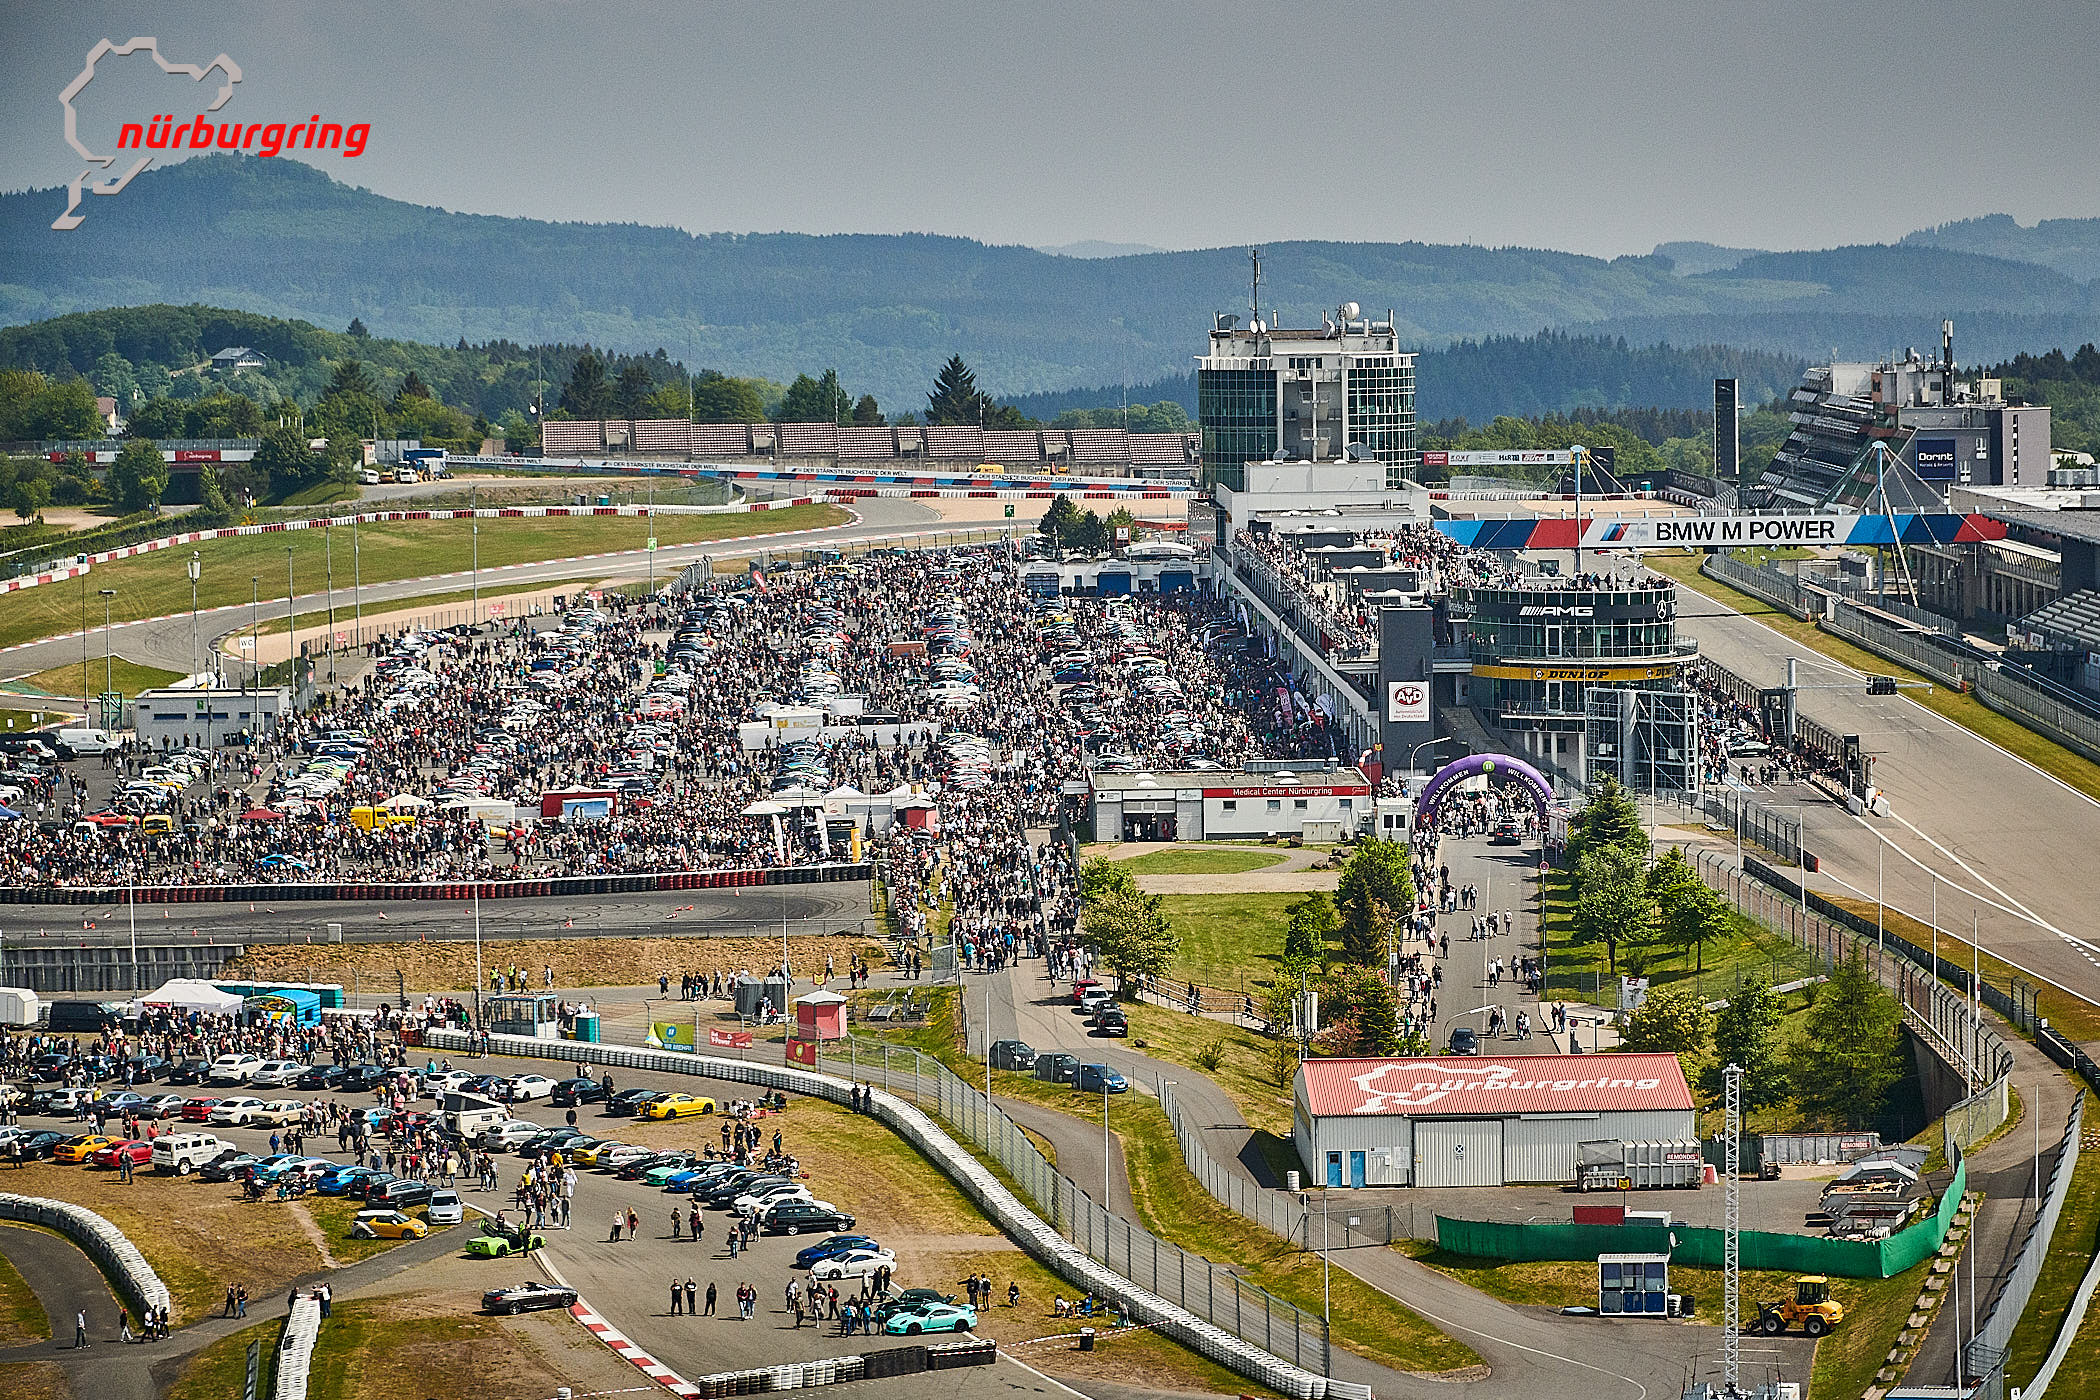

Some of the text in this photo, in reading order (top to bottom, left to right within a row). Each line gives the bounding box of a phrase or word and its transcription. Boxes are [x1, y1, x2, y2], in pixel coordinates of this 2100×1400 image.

[1918, 452, 1954, 461] Dorint
[1656, 521, 1716, 541] BMW
[1722, 521, 1742, 540] M
[1749, 520, 1835, 540] POWER
[1540, 606, 1594, 617] AMG
[240, 639, 254, 647] WC
[1548, 670, 1610, 679] DUNLOP
[1428, 769, 1469, 805] WILLKOMMEN
[1507, 767, 1548, 803] WILLKOMMEN
[1233, 786, 1333, 796] Medical Center Nürburgring
[1412, 1077, 1660, 1092] nürburgring
[1666, 1153, 1696, 1161] REMONDIS
